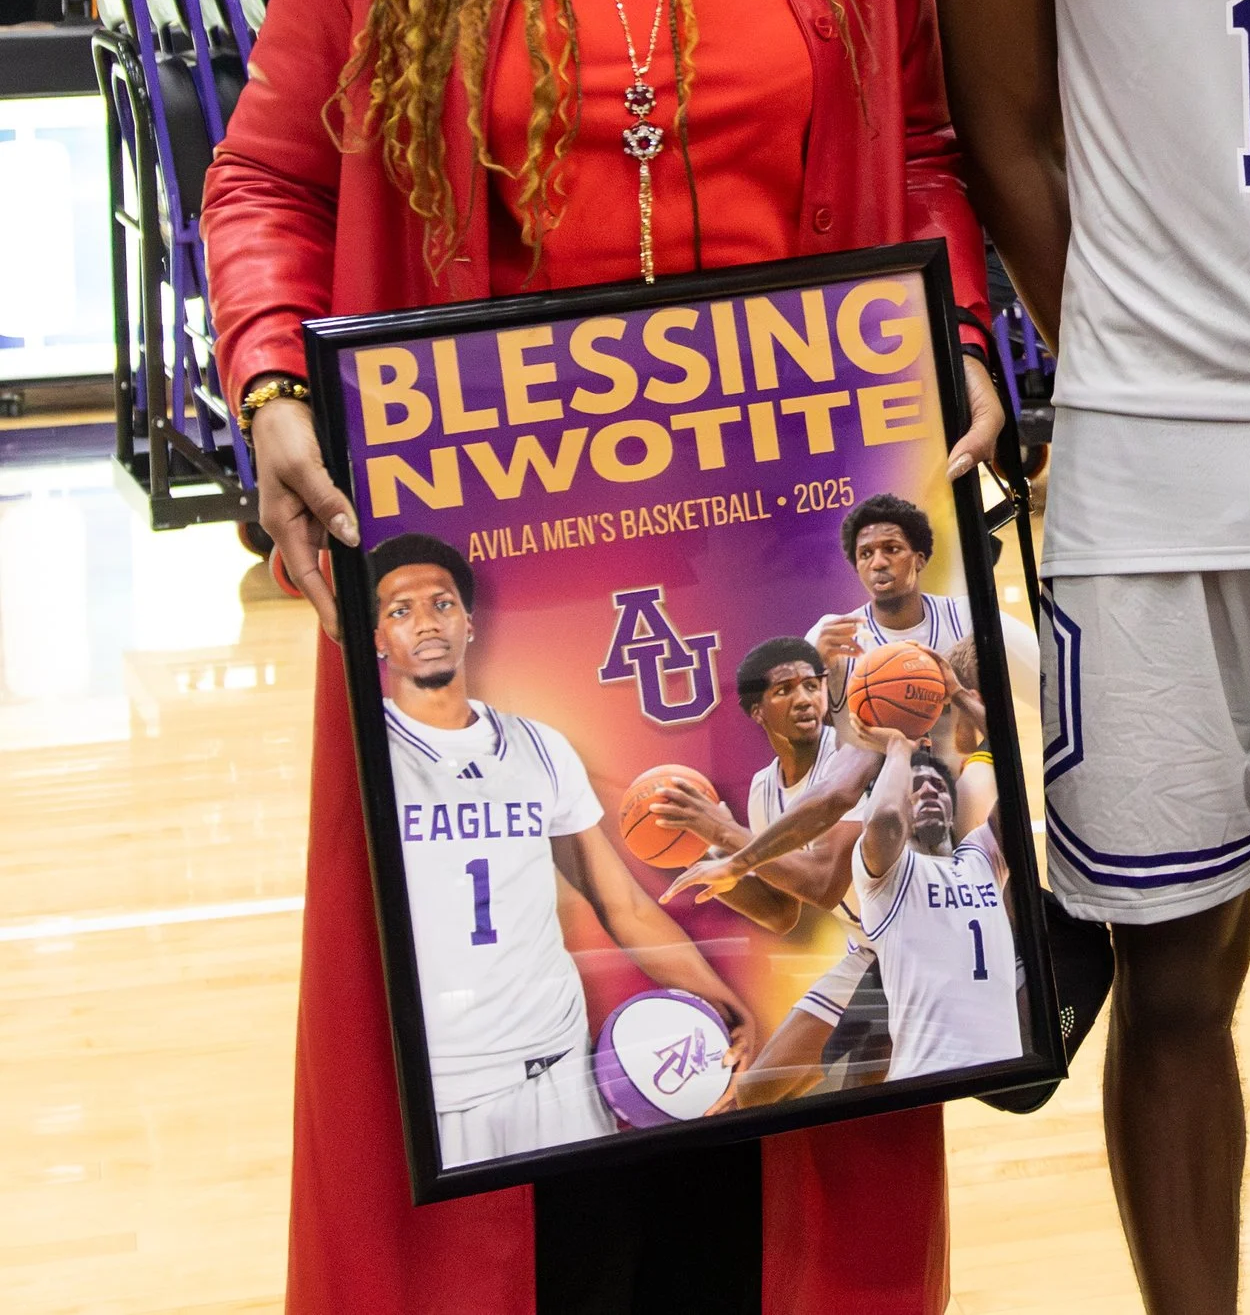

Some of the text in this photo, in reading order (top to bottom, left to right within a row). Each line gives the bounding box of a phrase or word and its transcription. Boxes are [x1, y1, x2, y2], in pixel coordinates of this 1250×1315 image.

[354, 281, 922, 445] BLESSING
[366, 381, 929, 518] NWOTITE
[467, 476, 856, 563] AVILA MEN'S BASKETBALL 2025
[403, 802, 543, 842] EAGLES
[465, 858, 498, 946] 1
[967, 918, 989, 982] 1
